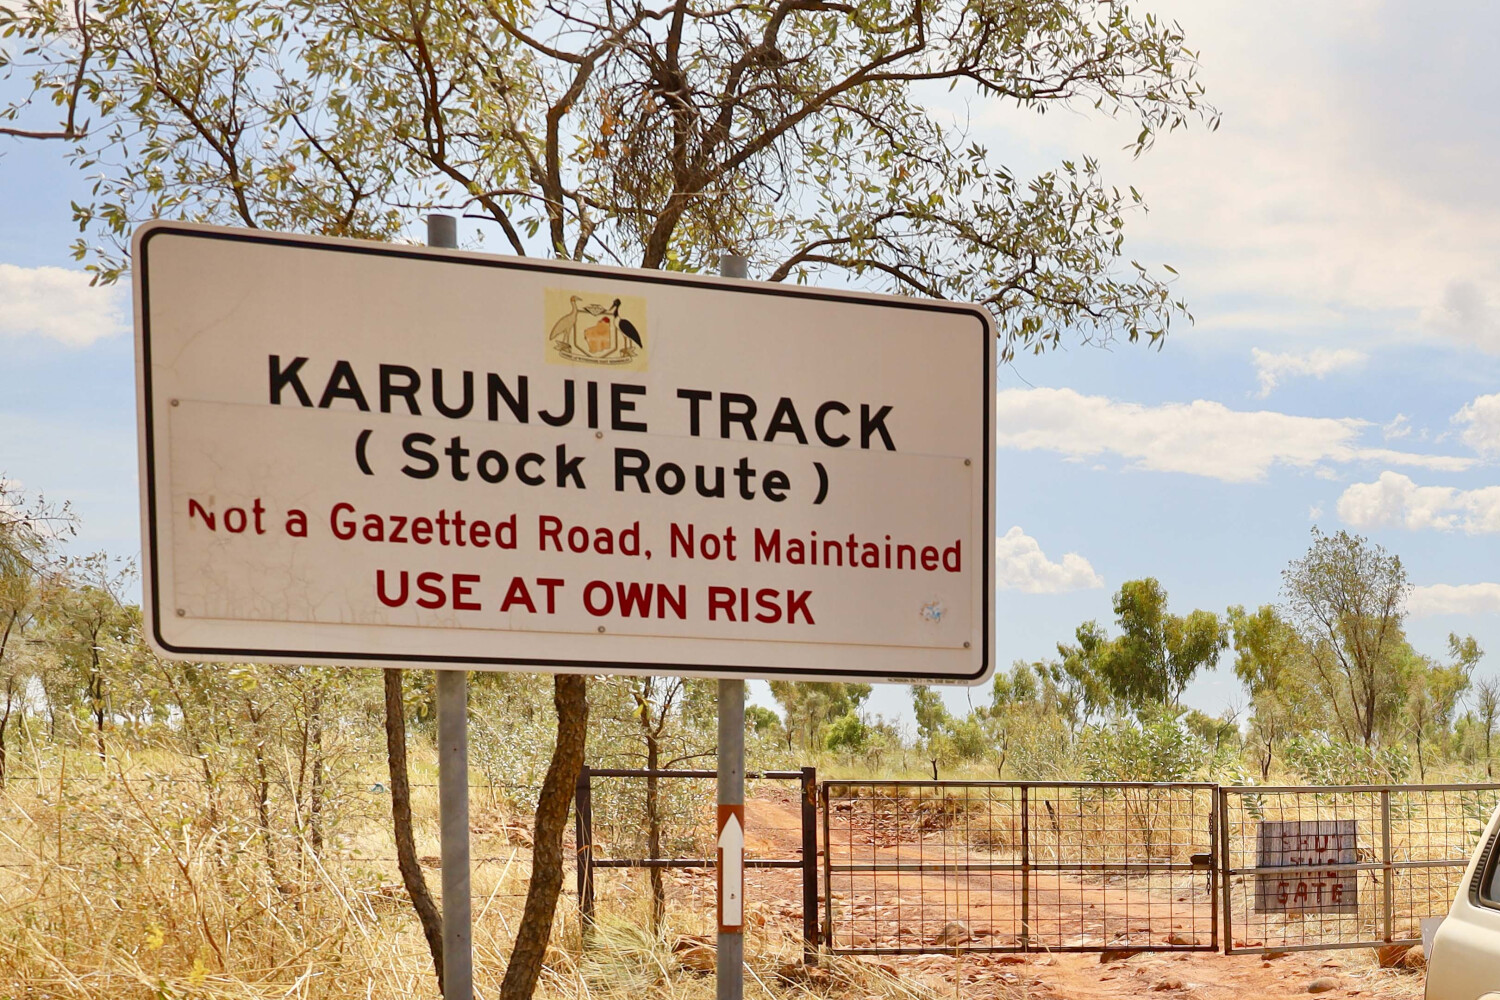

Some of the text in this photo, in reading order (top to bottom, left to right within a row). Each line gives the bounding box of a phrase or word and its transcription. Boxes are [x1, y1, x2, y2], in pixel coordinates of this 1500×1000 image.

[268, 354, 897, 452] KARUNJIE TRACK
[188, 498, 962, 573] Not a Gazetted Road, Not Maintained
[376, 569, 816, 625] USE AT OWN RISK
[1277, 882, 1342, 904] GATE
